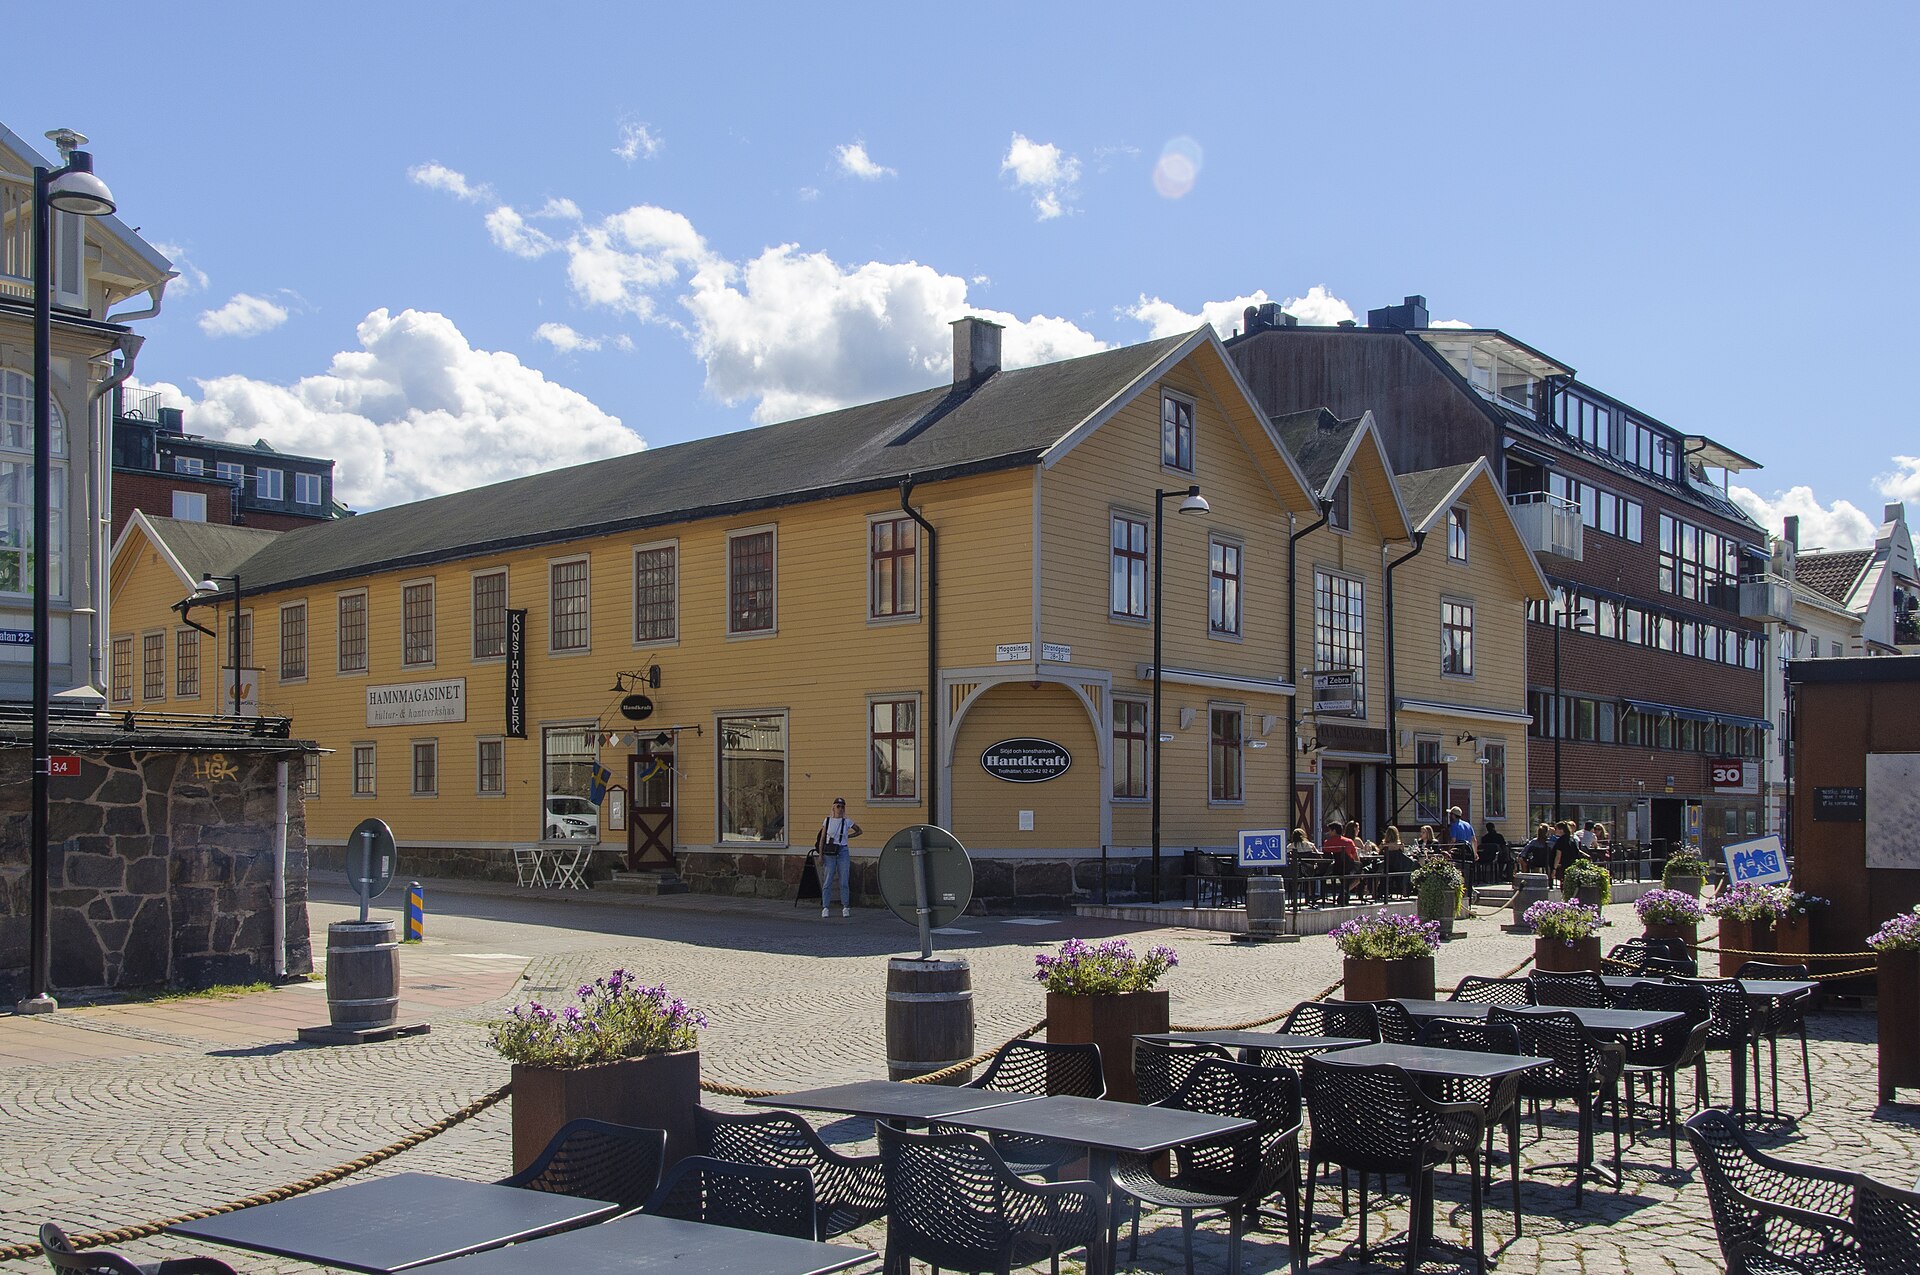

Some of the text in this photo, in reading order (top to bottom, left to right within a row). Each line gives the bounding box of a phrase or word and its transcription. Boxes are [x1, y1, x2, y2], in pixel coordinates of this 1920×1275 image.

[0, 632, 16, 641] atan
[511, 614, 520, 733] KONSTHANTVERK
[1329, 676, 1350, 684] Zebra
[369, 685, 461, 705] HAMNMAGASINET
[399, 709, 406, 719] &
[986, 755, 1066, 766] Handkraft
[52, 762, 68, 772] 3,4
[1712, 768, 1740, 782] 30
